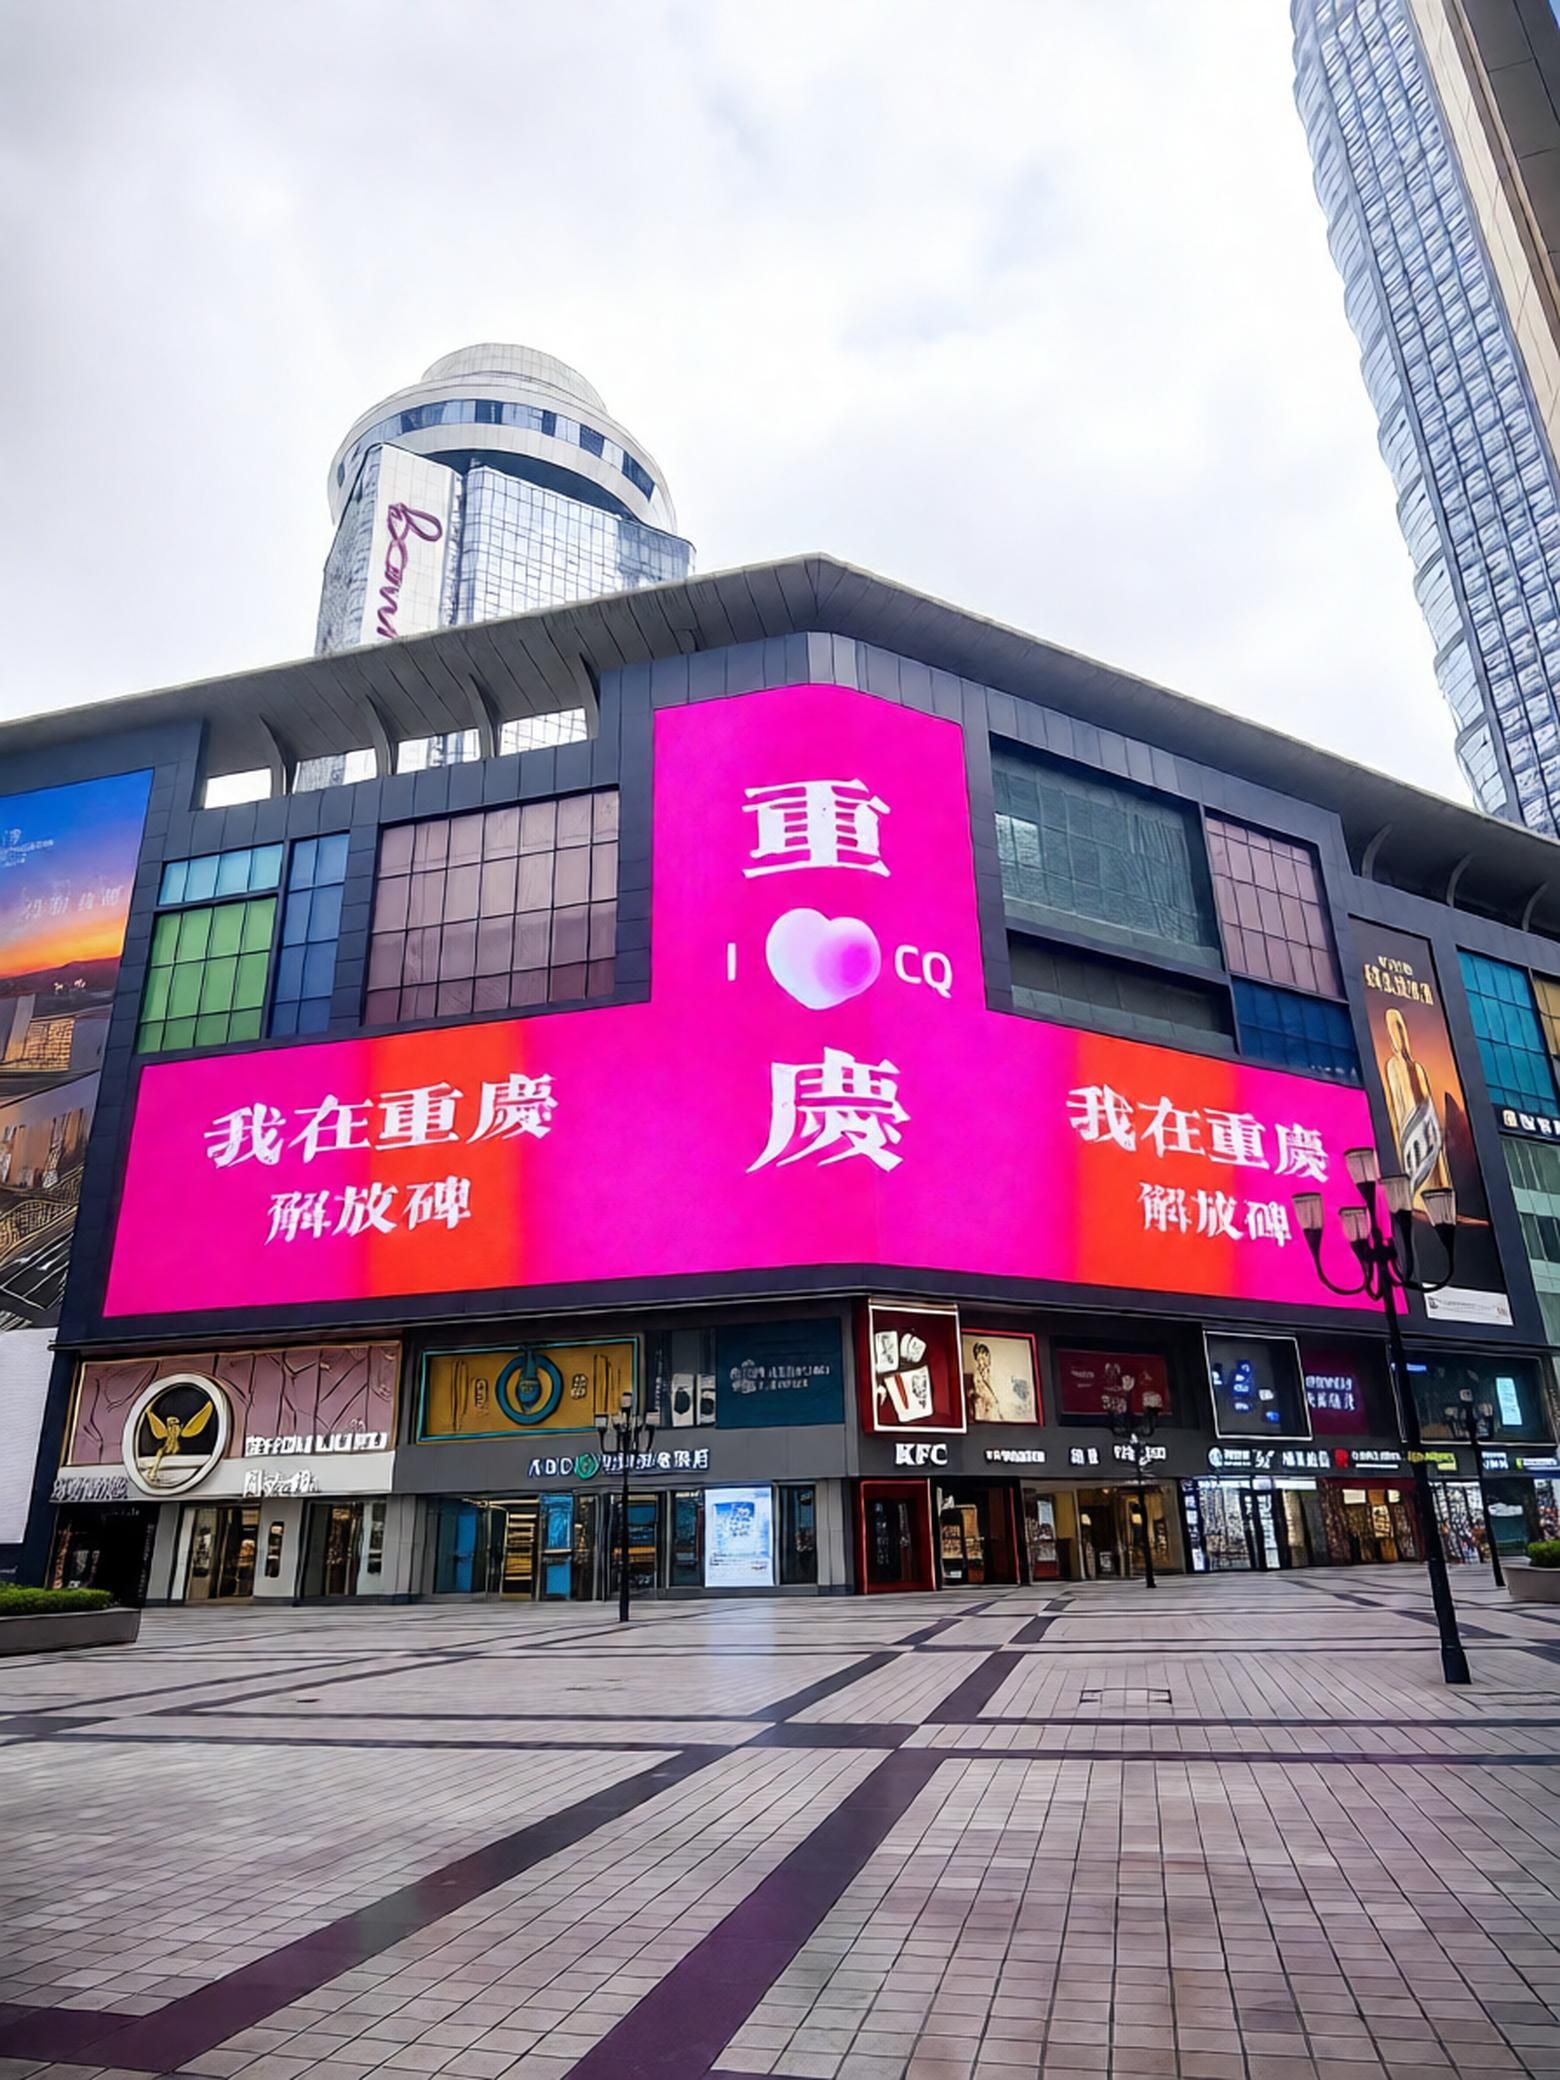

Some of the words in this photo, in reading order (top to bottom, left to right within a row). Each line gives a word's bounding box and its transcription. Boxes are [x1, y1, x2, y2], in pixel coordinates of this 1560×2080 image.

[742, 778, 891, 878] 重
[727, 943, 736, 981] I
[894, 945, 953, 998] CQ
[203, 1073, 560, 1168] 我在重慶
[746, 1046, 911, 1173] 慶
[1066, 1084, 1329, 1182] 我在重慶
[265, 1176, 472, 1245] 解放碑
[1137, 1182, 1292, 1247] 解放碑
[895, 1443, 948, 1466] KFC
